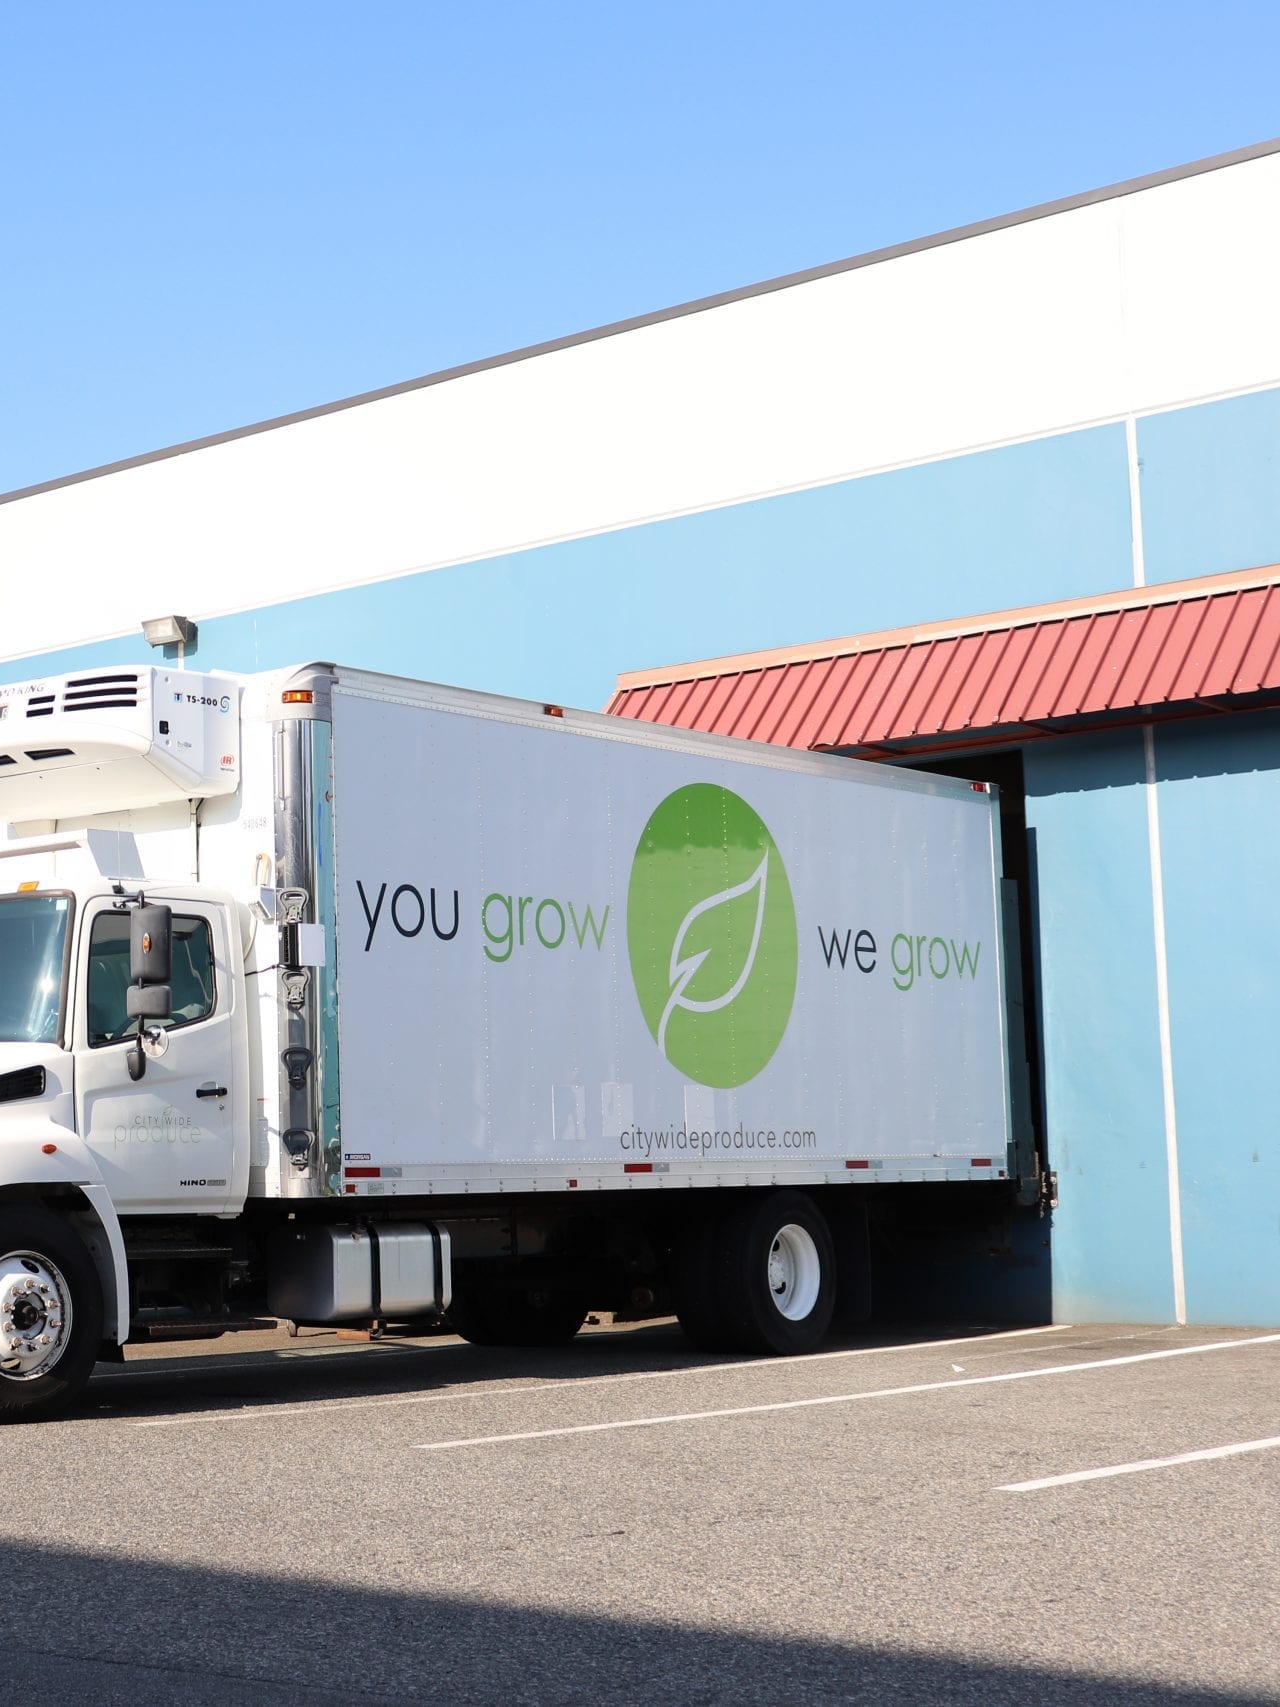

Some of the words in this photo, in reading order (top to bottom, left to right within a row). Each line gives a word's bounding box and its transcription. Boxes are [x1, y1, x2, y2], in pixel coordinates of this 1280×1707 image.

[16, 683, 46, 696] KING
[186, 694, 218, 707] TS-200
[355, 879, 460, 952] you
[481, 892, 611, 963] grow
[817, 925, 877, 974] we
[890, 932, 982, 992] grow
[134, 1115, 159, 1125] CITY
[164, 1116, 192, 1126] WIDE
[114, 1121, 202, 1152] produce
[619, 1121, 817, 1158] citywideproduce.com
[179, 1179, 207, 1187] HINO
